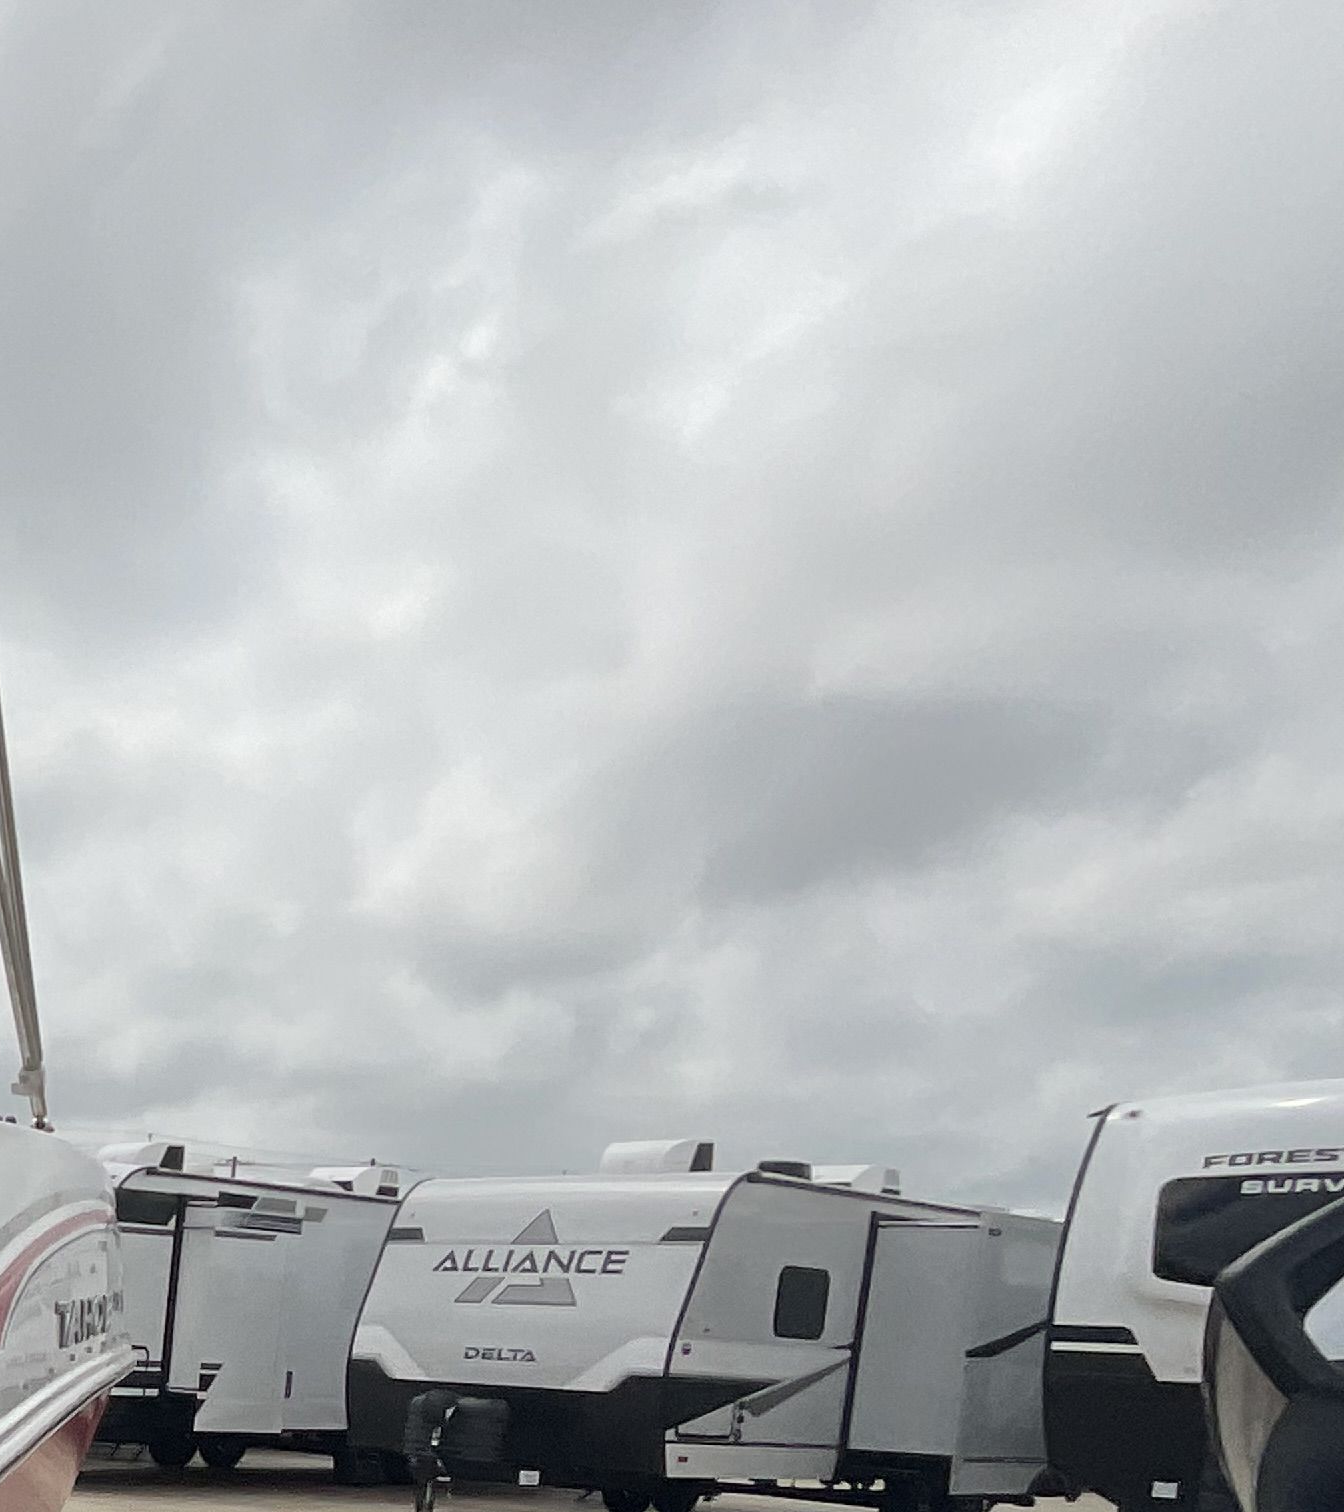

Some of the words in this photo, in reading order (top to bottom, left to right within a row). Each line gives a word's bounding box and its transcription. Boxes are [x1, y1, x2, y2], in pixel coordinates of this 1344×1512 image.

[1202, 1147, 1344, 1169] FORES
[432, 1249, 630, 1275] ALLIANCE
[463, 1346, 537, 1362] DELTA
